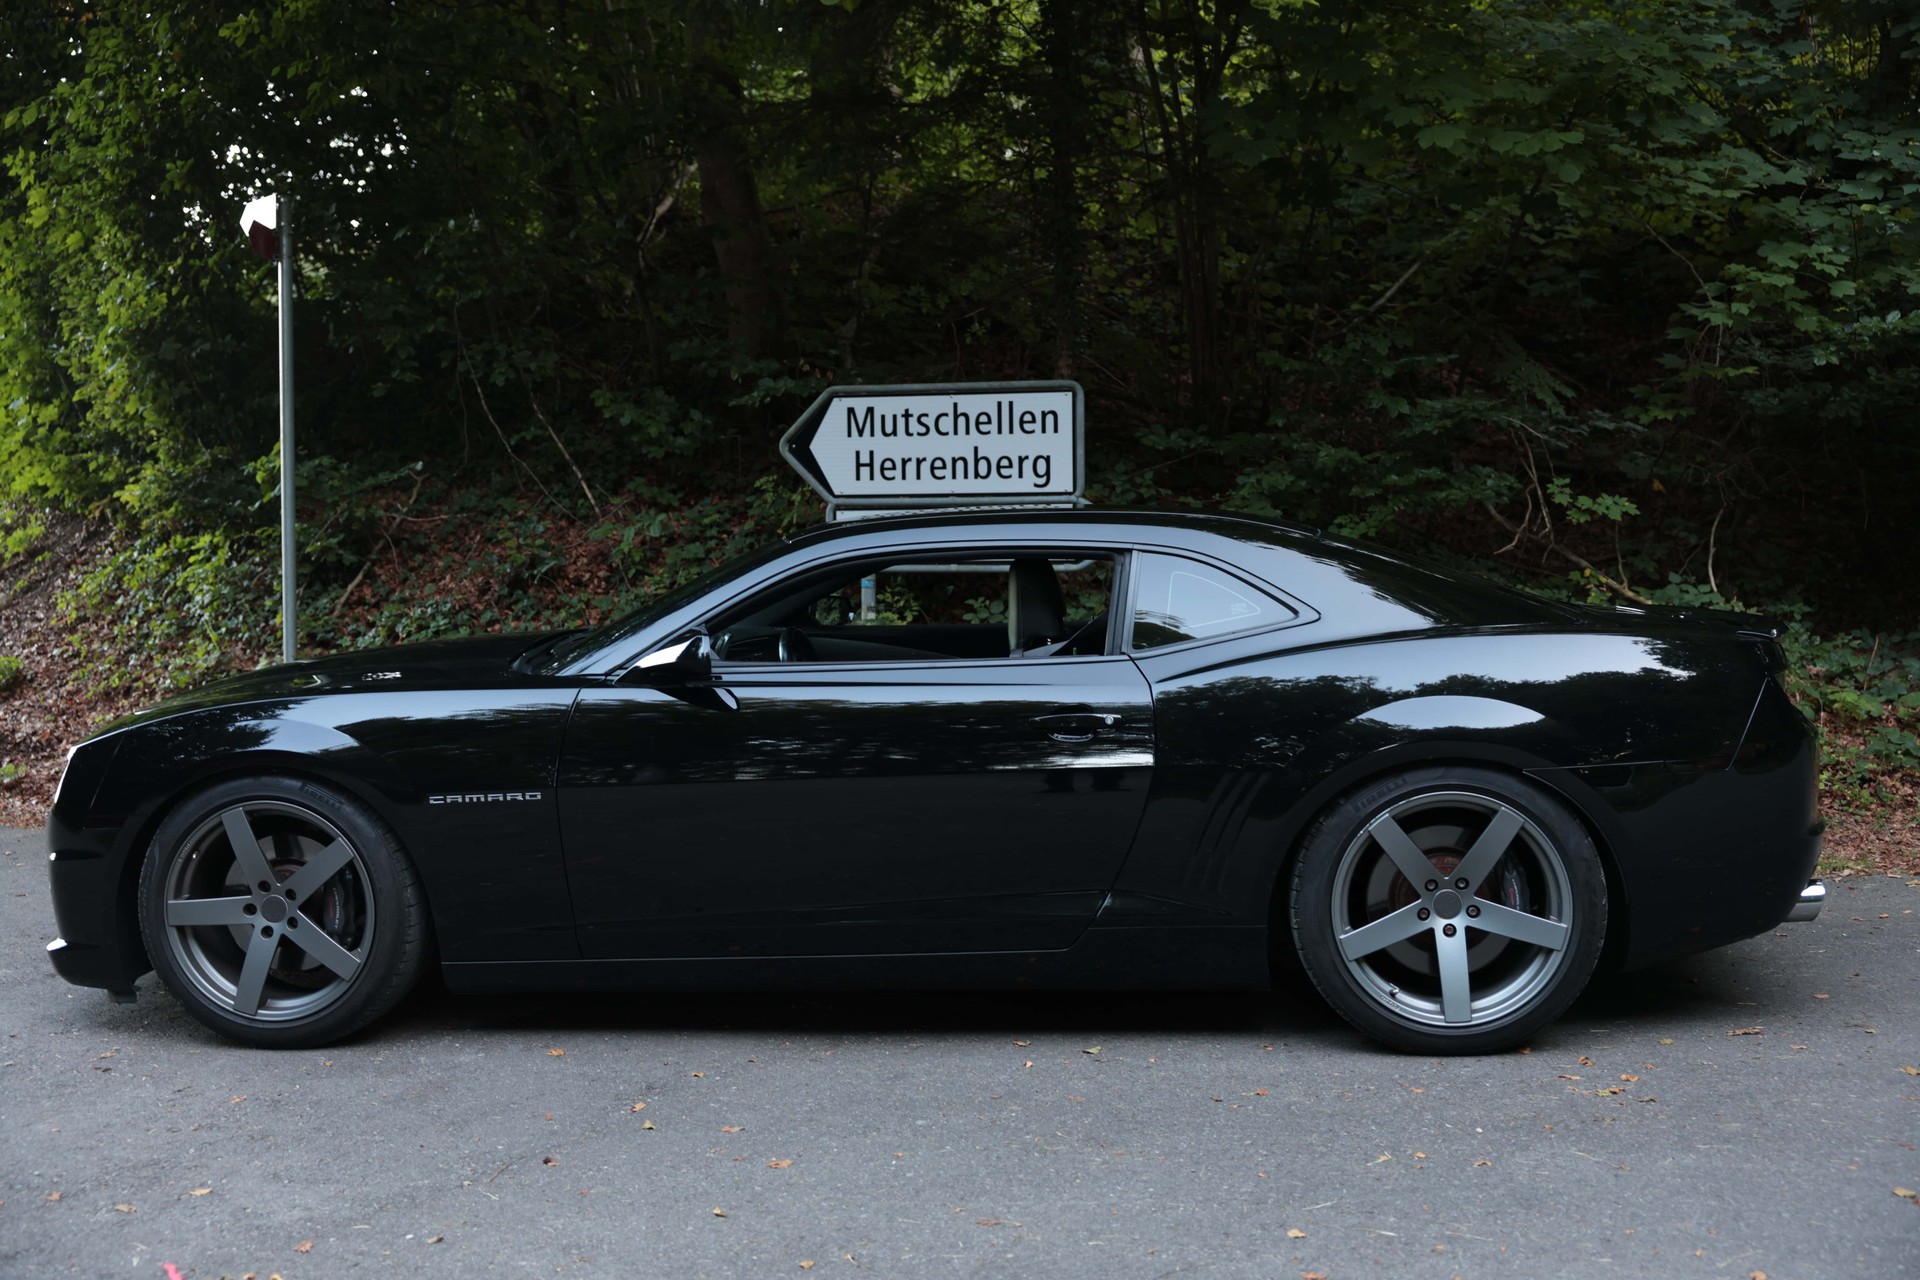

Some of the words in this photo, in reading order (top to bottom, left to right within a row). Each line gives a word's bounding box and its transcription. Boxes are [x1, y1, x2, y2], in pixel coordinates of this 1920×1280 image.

[846, 400, 1059, 438] Mutschellen
[855, 446, 1051, 488] Herrenberg
[429, 792, 542, 805] CAMARO
